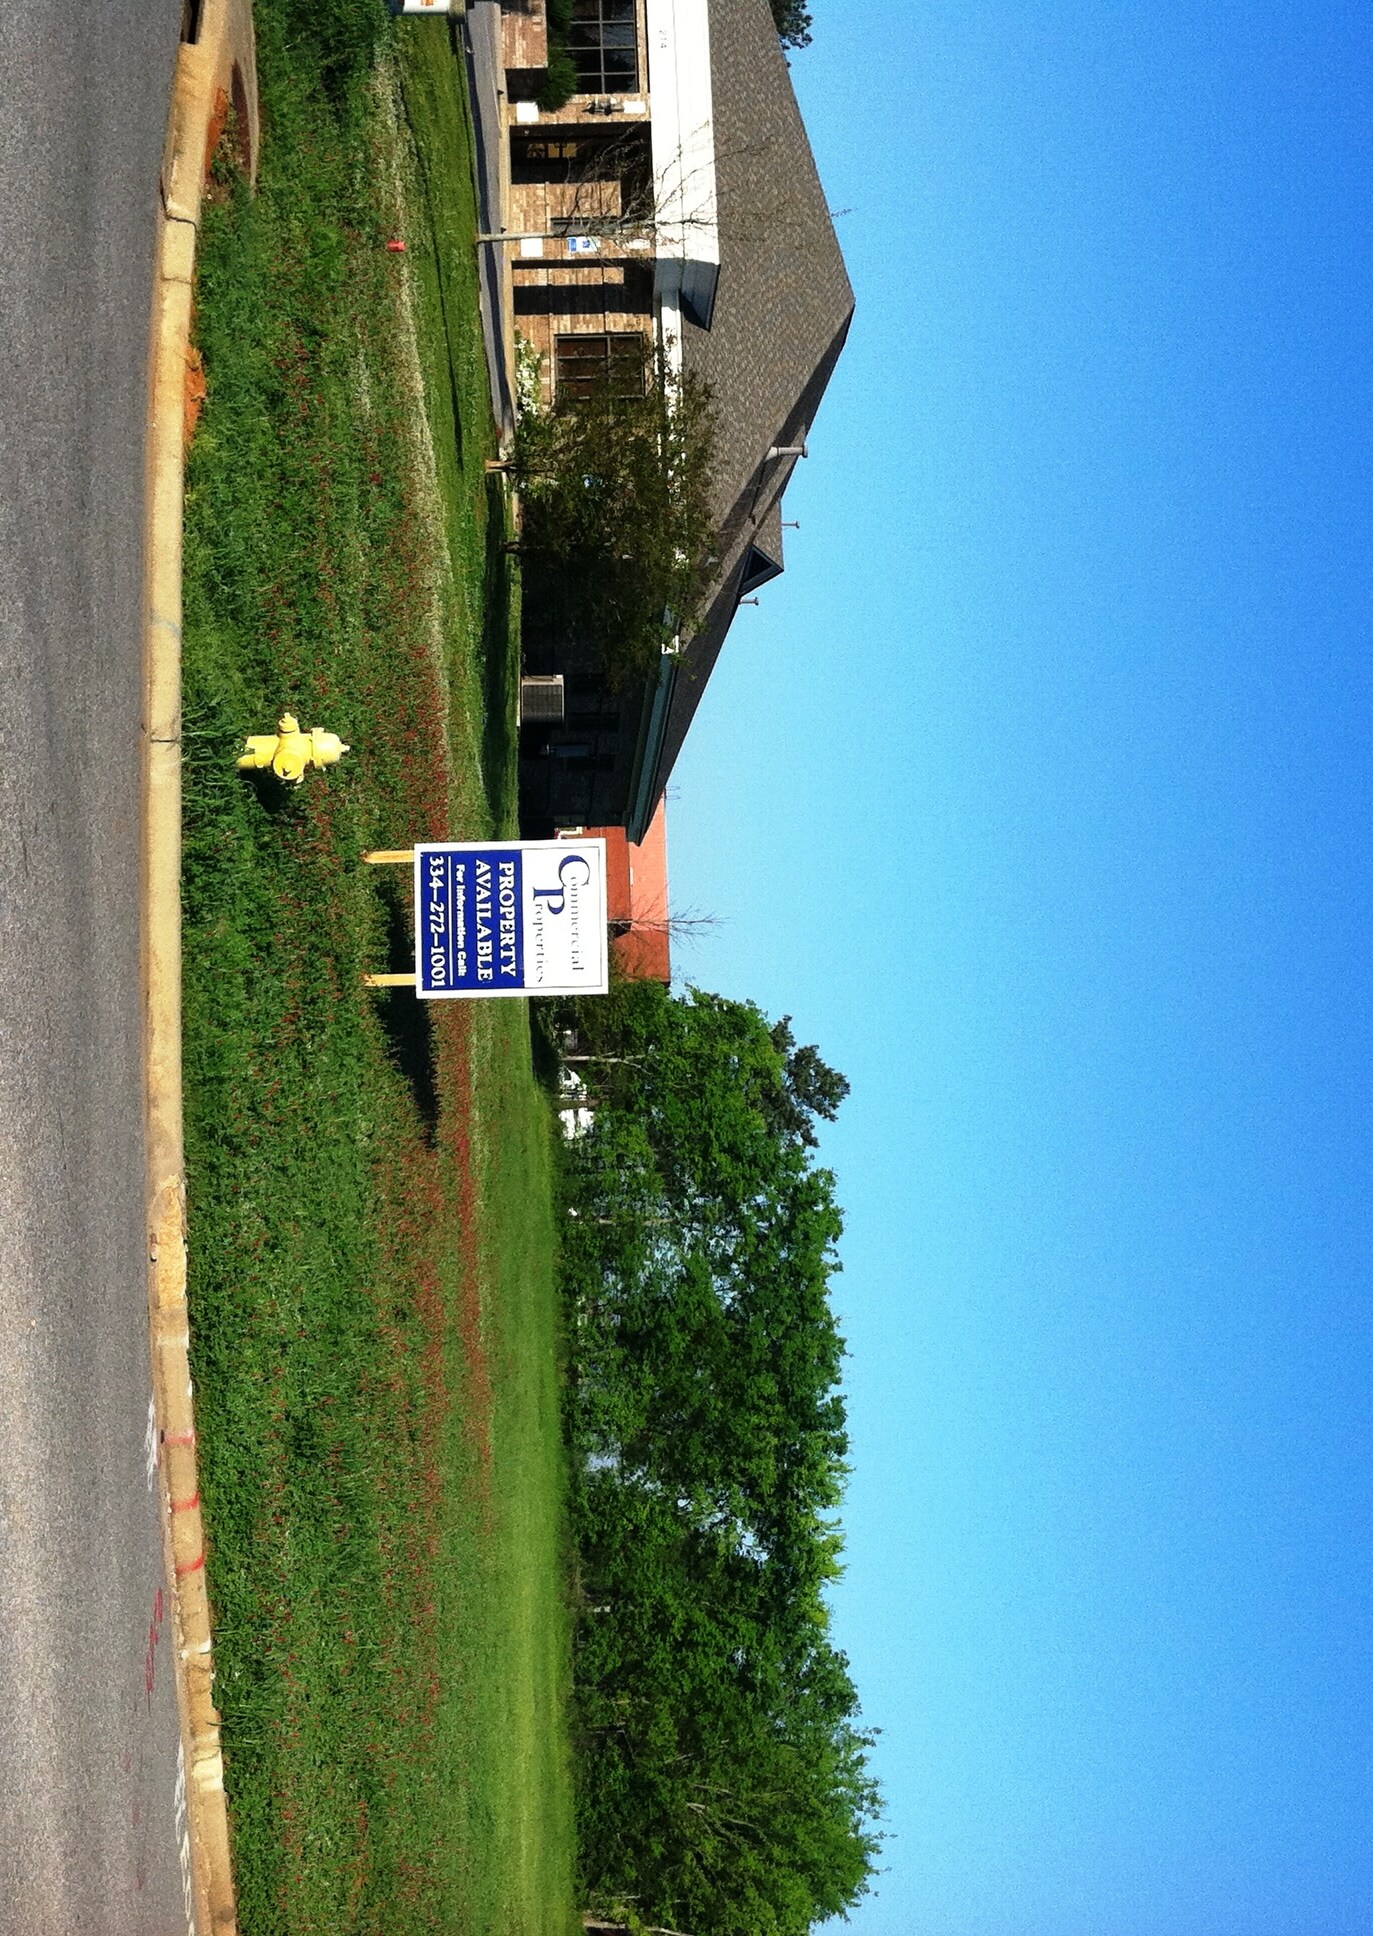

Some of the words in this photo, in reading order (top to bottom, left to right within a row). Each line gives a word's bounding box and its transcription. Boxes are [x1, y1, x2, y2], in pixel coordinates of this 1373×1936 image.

[428, 856, 446, 988] 334-272-1001
[456, 864, 465, 883] For
[456, 886, 466, 948] Information
[476, 860, 493, 981] AVAILABLE
[498, 862, 516, 977] PROPERTY
[558, 855, 590, 971] Commercial
[457, 951, 466, 976] Call:
[532, 887, 565, 983] Properties
